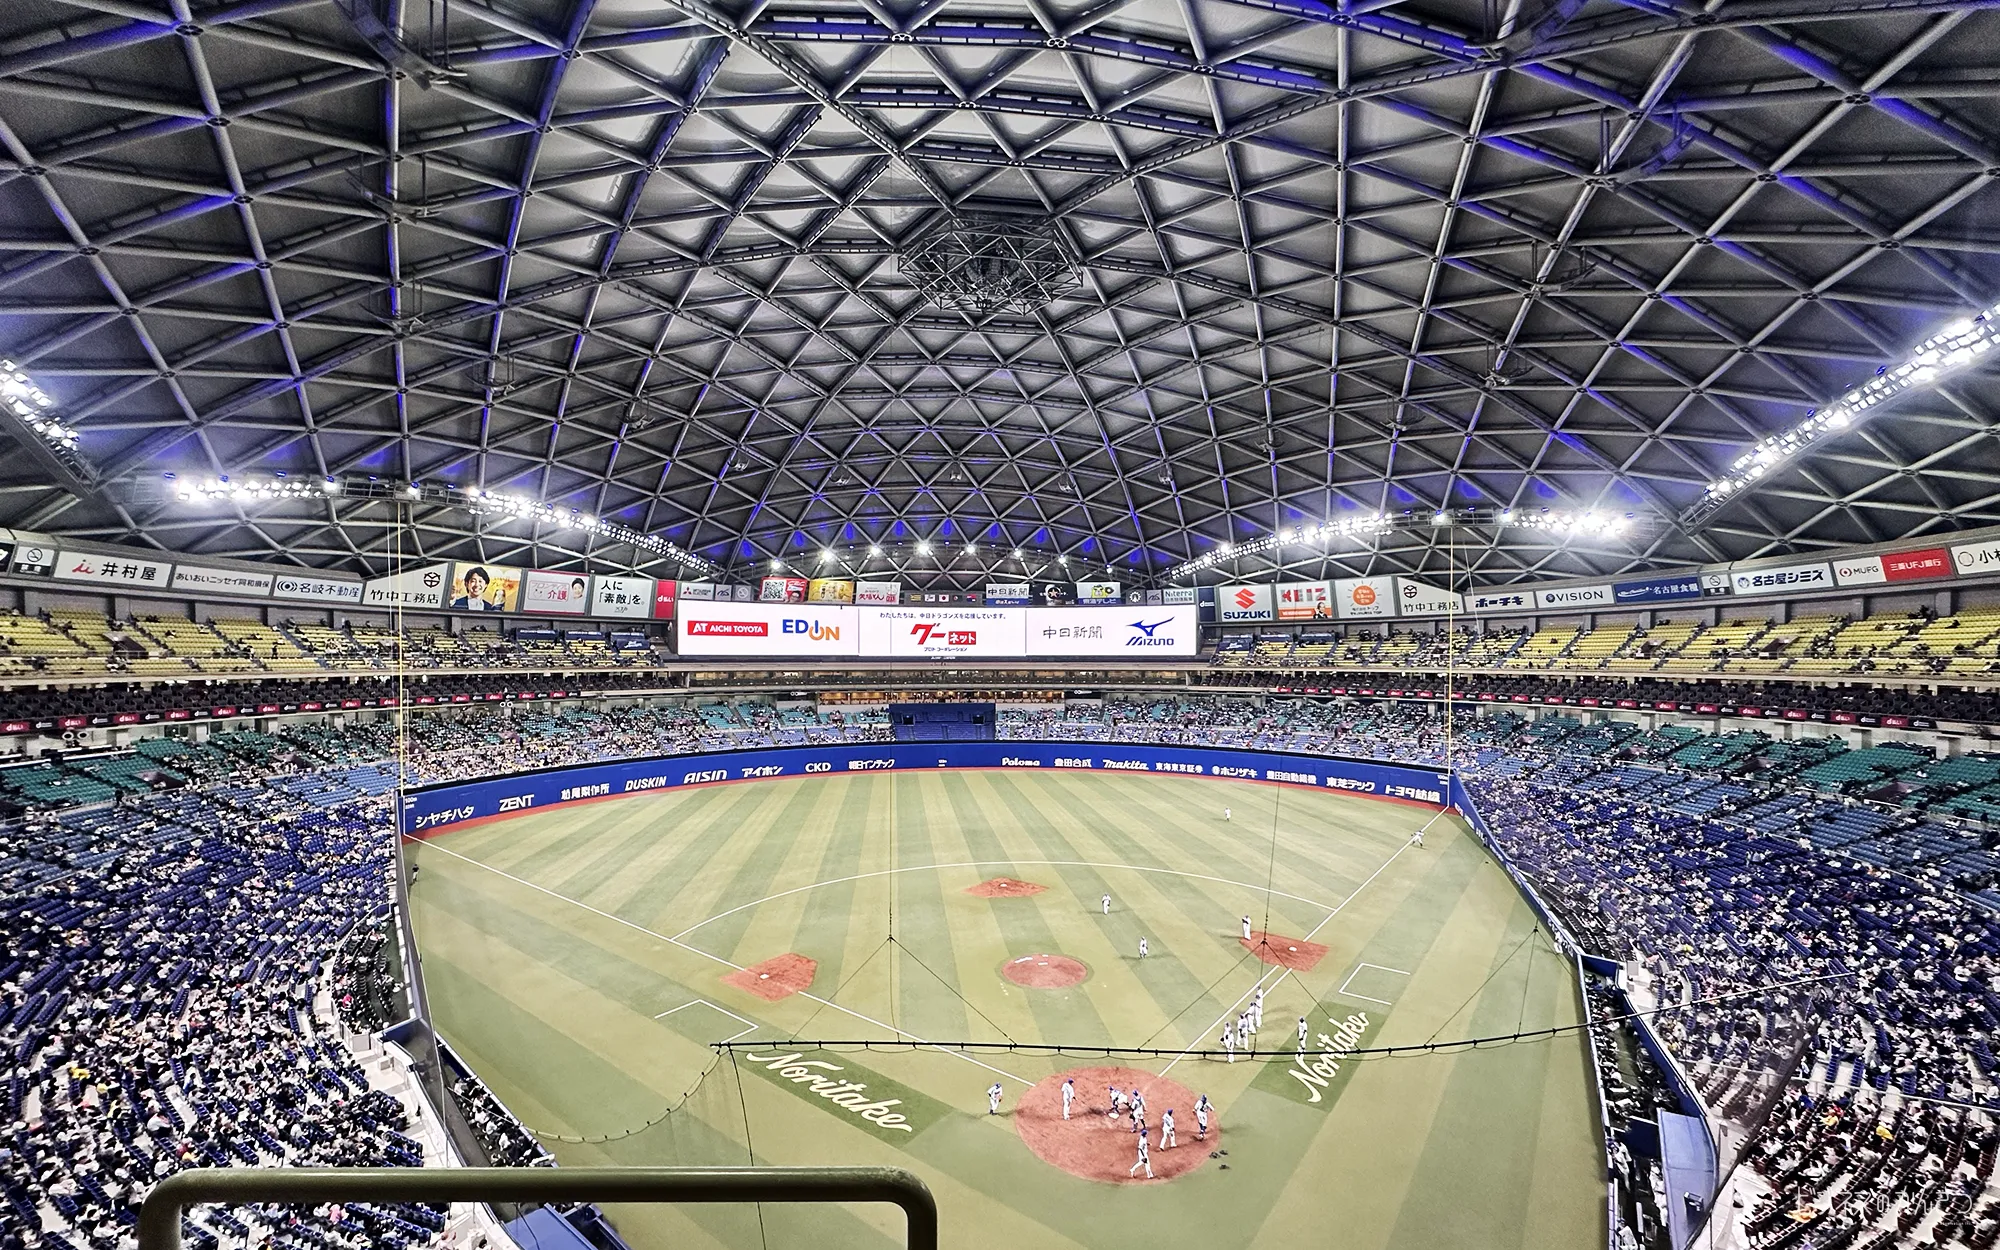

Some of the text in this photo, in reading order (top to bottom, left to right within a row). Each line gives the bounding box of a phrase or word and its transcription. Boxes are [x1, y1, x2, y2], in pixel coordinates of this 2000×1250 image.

[101, 561, 157, 580] 井村屋
[1854, 565, 1879, 575] MUFG
[1890, 558, 1941, 572] 三菱UFJ銀行
[175, 572, 270, 588] あいおいニッセイ同和損保
[1752, 568, 1824, 587] 名古屋シミズ
[299, 582, 361, 598] 名岐不動産
[601, 580, 623, 591] 人に
[988, 586, 1028, 596] 中日新聞
[1653, 583, 1699, 595] 名古屋食糧
[369, 588, 440, 605] 竹中工務店
[547, 589, 568, 600] 介護
[1165, 590, 1193, 598] Niterra
[1280, 588, 1327, 603] KEIZ
[1555, 590, 1604, 602] VISION
[1403, 601, 1459, 613] 竹中工務店
[1475, 595, 1524, 608] ホーチキ
[879, 612, 1007, 620] わたしたちは、中日ドラゴンズを応援しています。
[1223, 610, 1271, 620] SUZUKI
[709, 624, 732, 633] AICHI
[733, 625, 764, 634] TOYOTA
[782, 619, 840, 641] EDION
[1043, 626, 1103, 639] 中日新聞
[1125, 636, 1175, 646] MIZUNO
[805, 761, 832, 774] CKD
[848, 758, 896, 770] 朝日インテック
[1001, 756, 1041, 767] Paloma
[1155, 761, 1204, 774] 東海東京証券
[683, 769, 728, 784] AISIN
[741, 766, 784, 778] アイホン
[1266, 770, 1317, 785] 豊田自動織機
[624, 775, 667, 792] DUSKIN
[1326, 776, 1376, 792] 東芝テック
[1385, 784, 1441, 803] トヨタ紡織
[499, 794, 535, 811] ZENT
[1287, 1011, 1370, 1103] Noritake
[745, 1052, 913, 1133] Noritake
